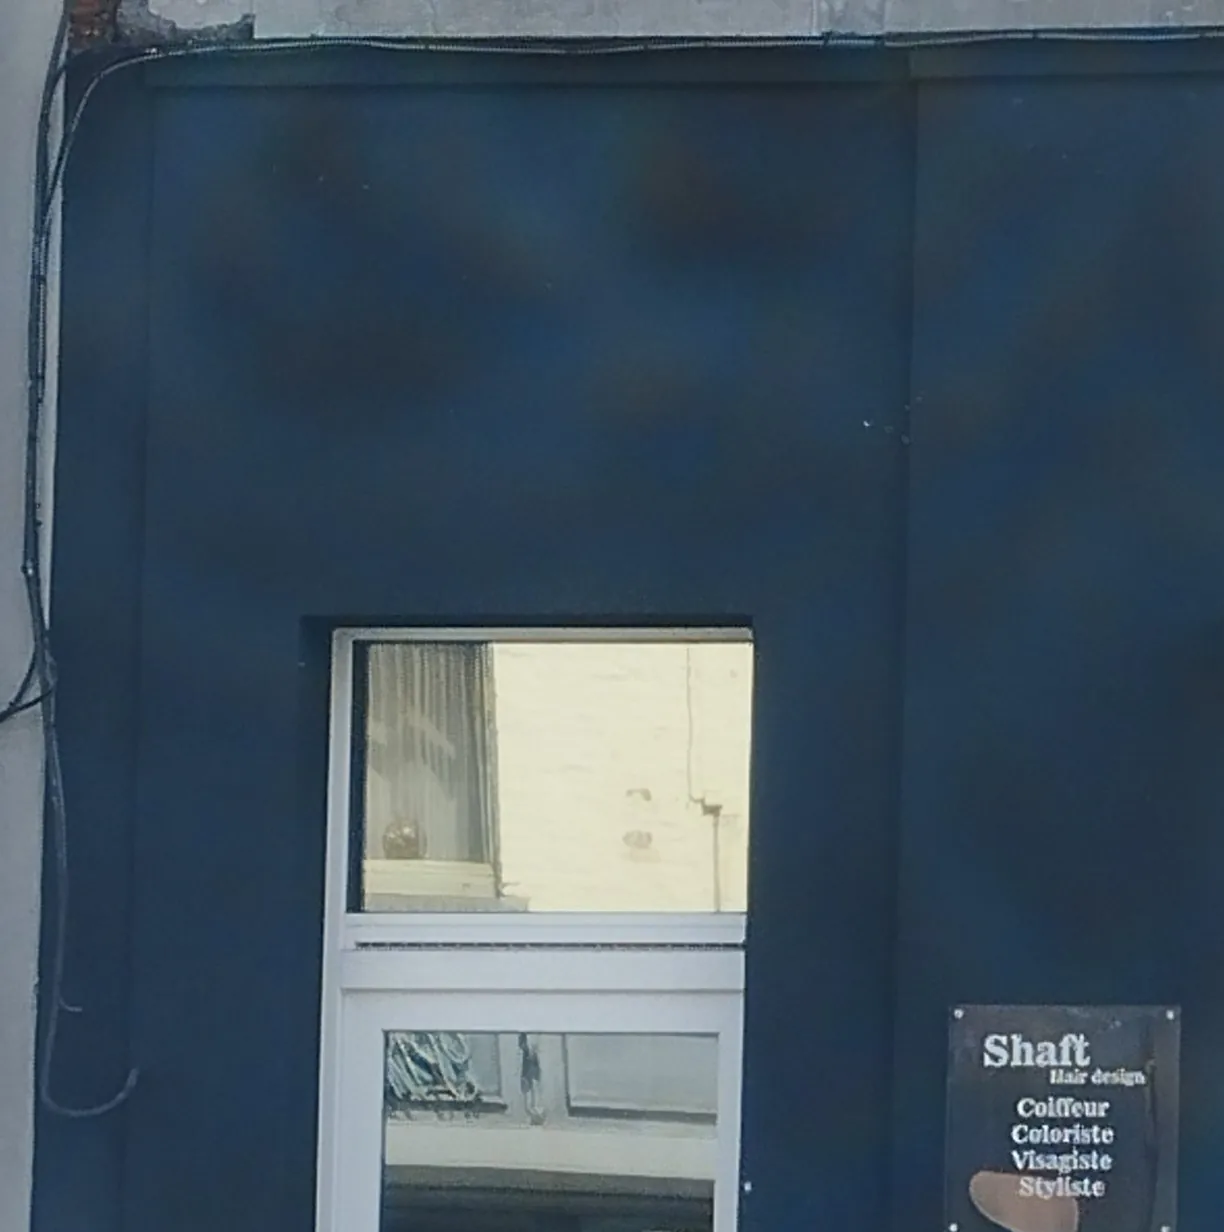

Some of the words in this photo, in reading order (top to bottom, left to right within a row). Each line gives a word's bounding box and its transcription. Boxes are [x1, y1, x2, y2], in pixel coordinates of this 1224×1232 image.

[983, 1033, 1091, 1068] Shaft
[1049, 1067, 1088, 1085] Hair
[1091, 1067, 1146, 1087] design
[1016, 1096, 1110, 1118] Coiffeur
[1010, 1123, 1115, 1145] Coloriste
[1010, 1146, 1113, 1174] Visagiste
[1018, 1175, 1106, 1200] Styliste
